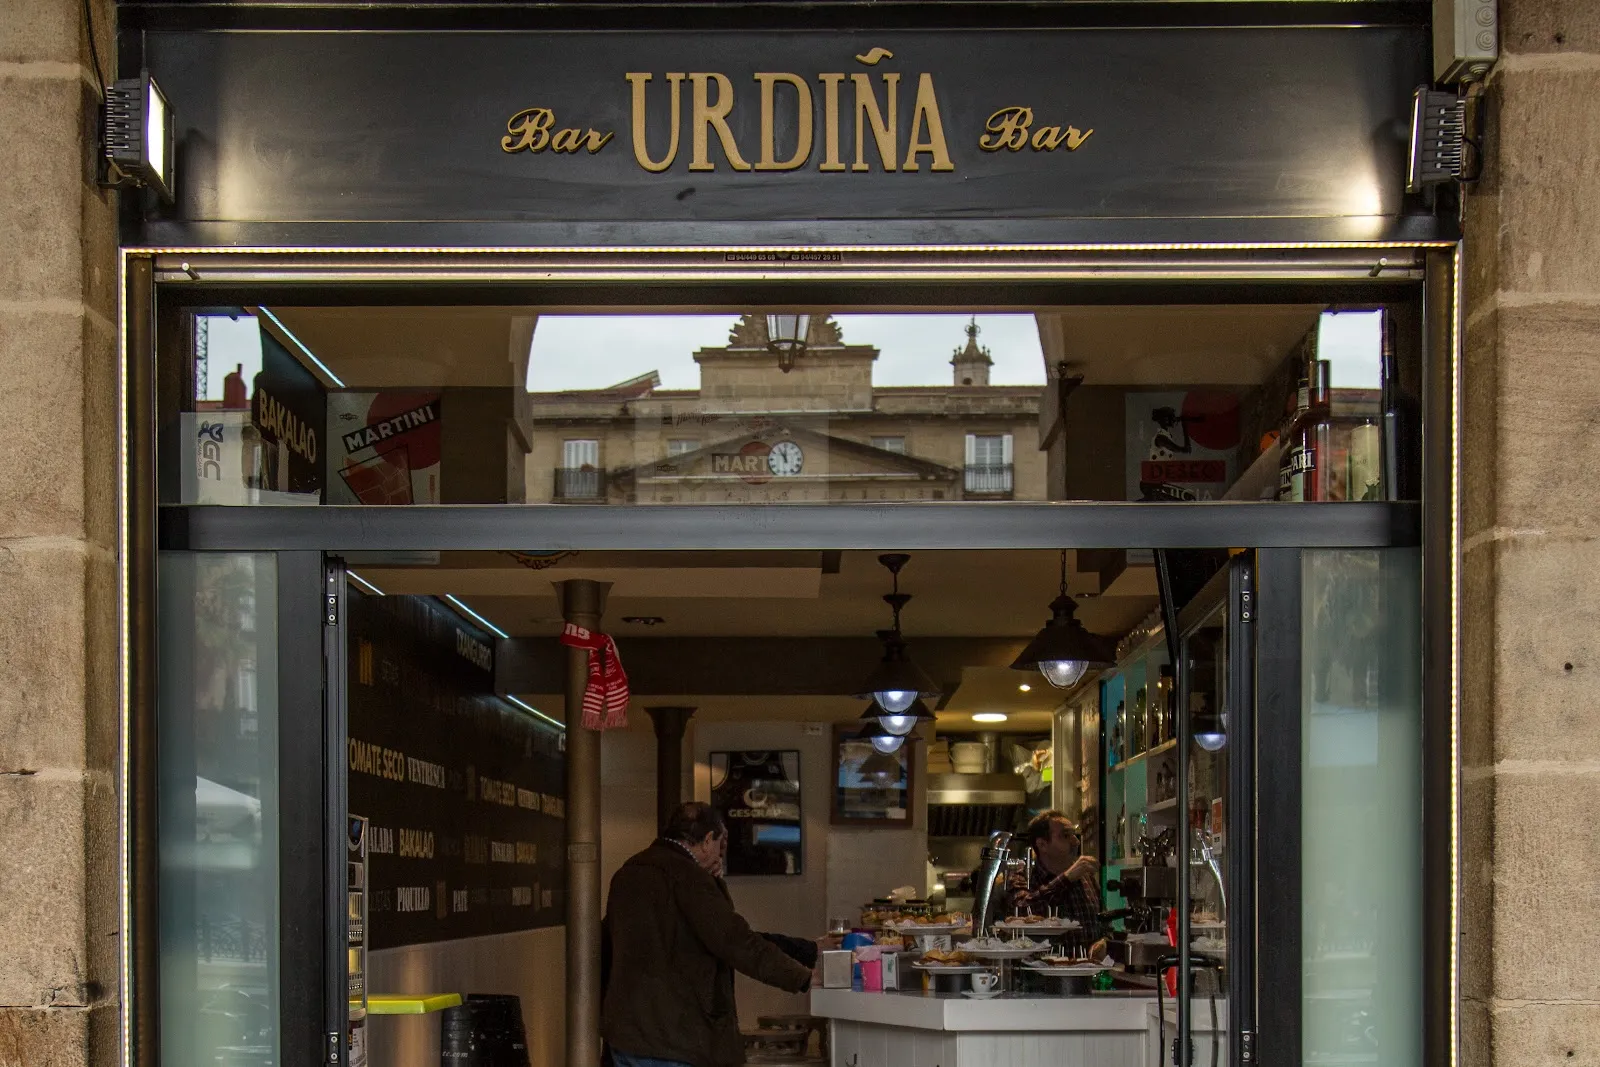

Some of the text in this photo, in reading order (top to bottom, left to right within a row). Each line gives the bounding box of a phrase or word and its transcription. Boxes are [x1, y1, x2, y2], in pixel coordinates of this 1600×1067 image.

[500, 47, 1094, 173] Bar URDIÑA Bar
[258, 387, 317, 465] BAKALAO
[345, 405, 436, 451] MARTINI
[714, 455, 788, 472] MART
[347, 737, 382, 777] OMATE
[383, 748, 405, 782] SECO
[399, 827, 435, 859] BAKALAO
